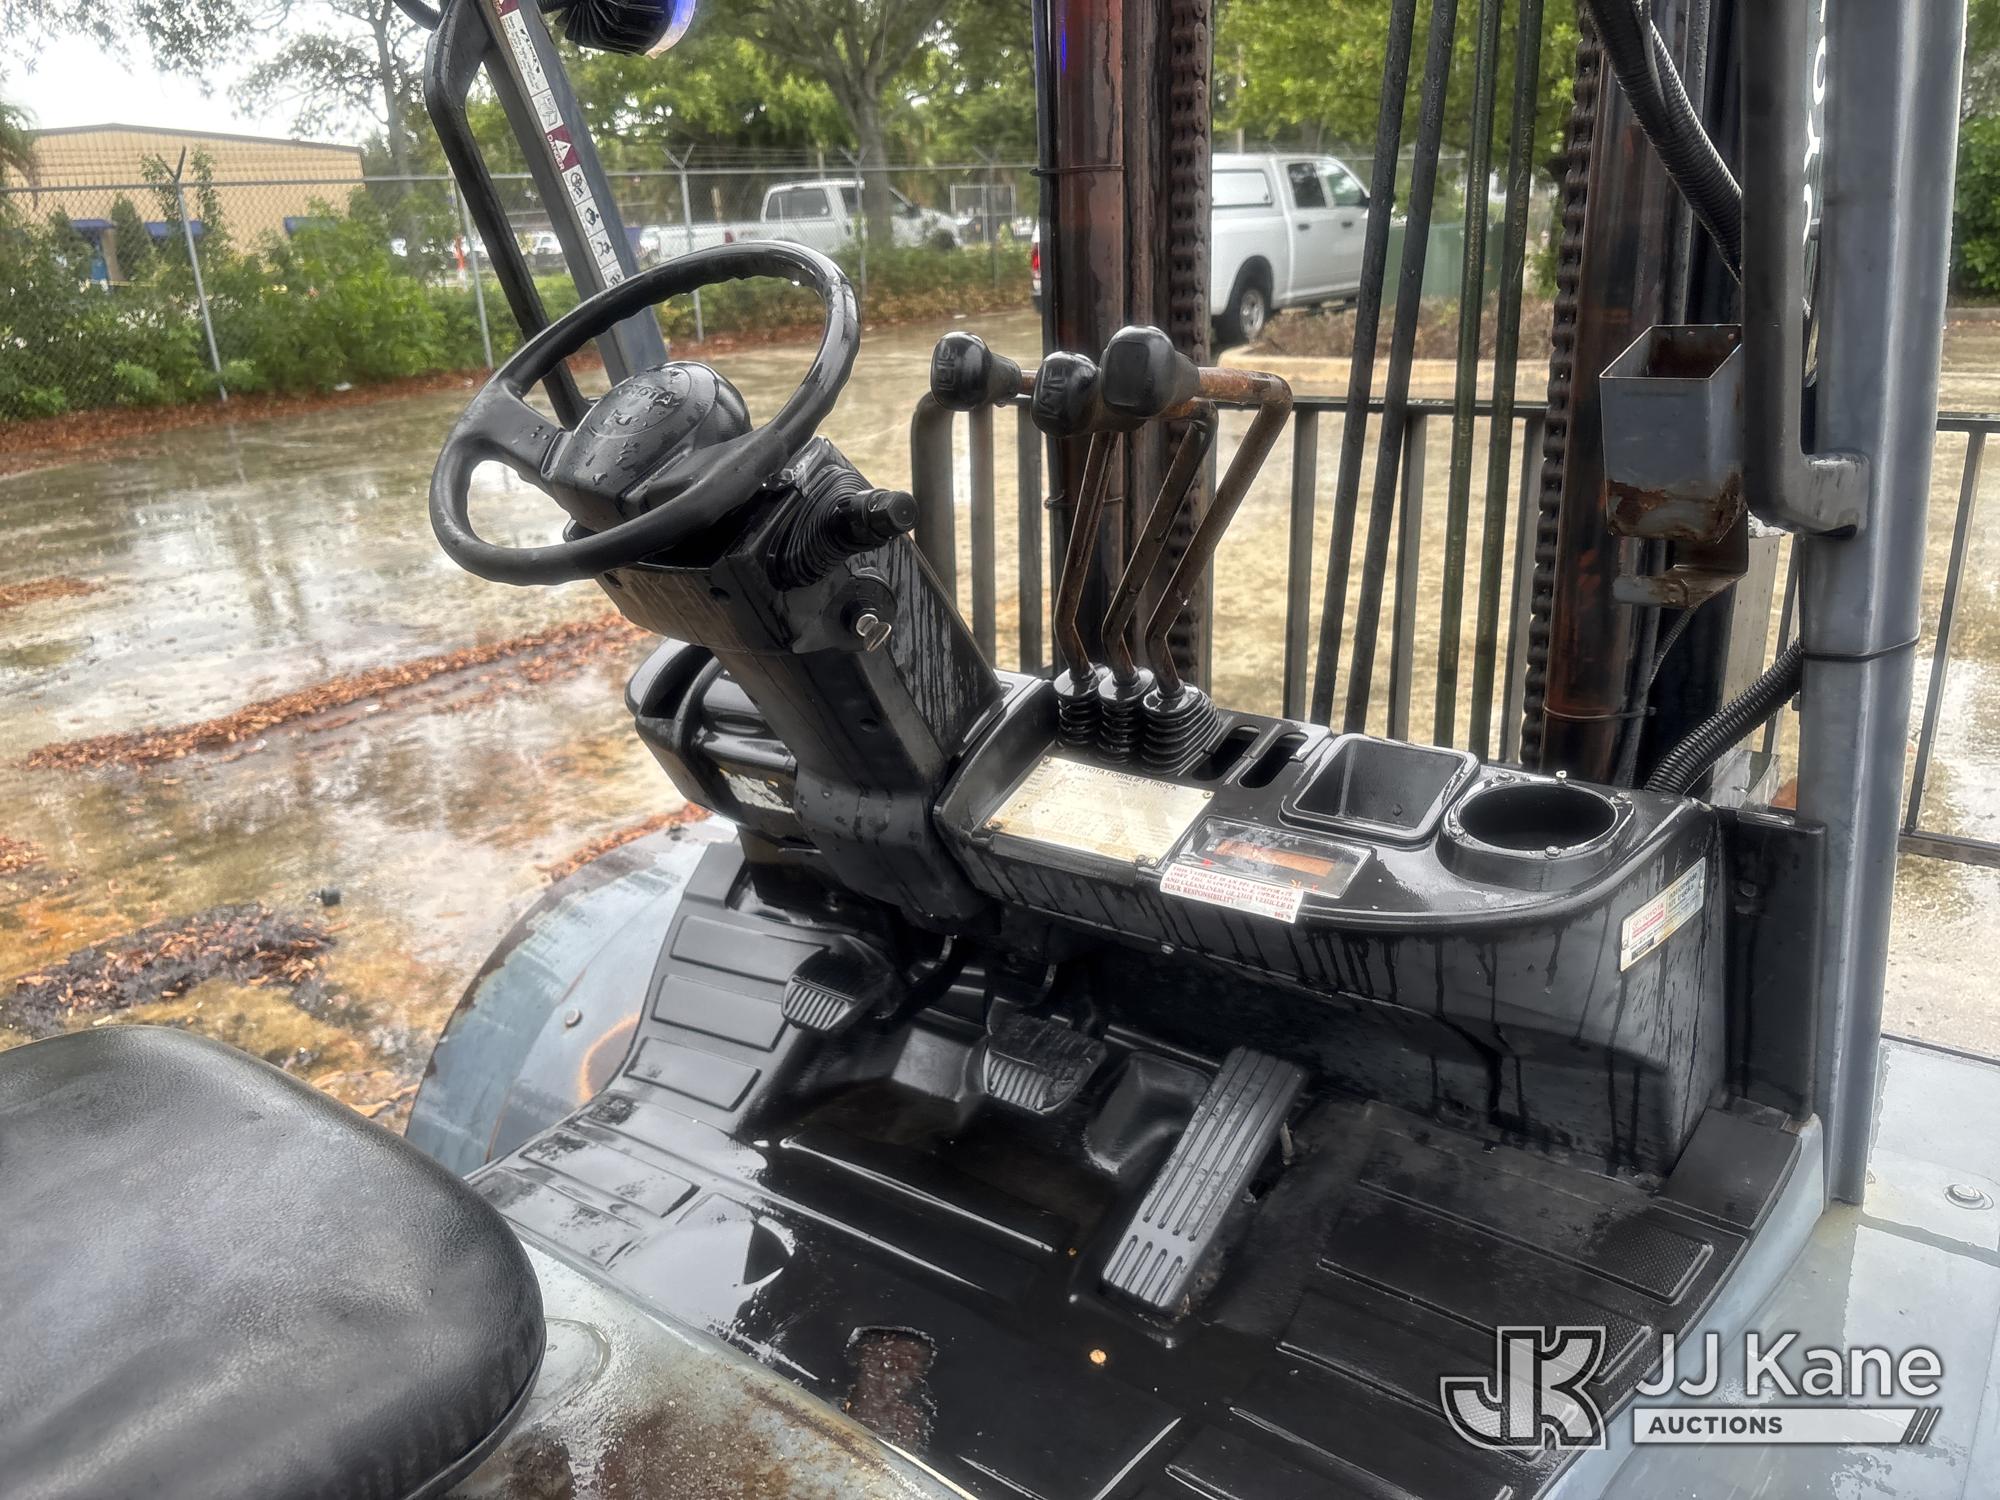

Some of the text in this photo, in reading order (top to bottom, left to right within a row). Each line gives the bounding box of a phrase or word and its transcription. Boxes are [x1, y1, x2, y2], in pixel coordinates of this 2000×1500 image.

[547, 134, 565, 170] DANGER
[1073, 763, 1105, 777] TOYOTA
[1106, 770, 1148, 785] FORKLIFT
[1149, 779, 1177, 791] TRUCK
[1163, 882, 1182, 892] YOUR
[1254, 895, 1286, 908] VEHICLE
